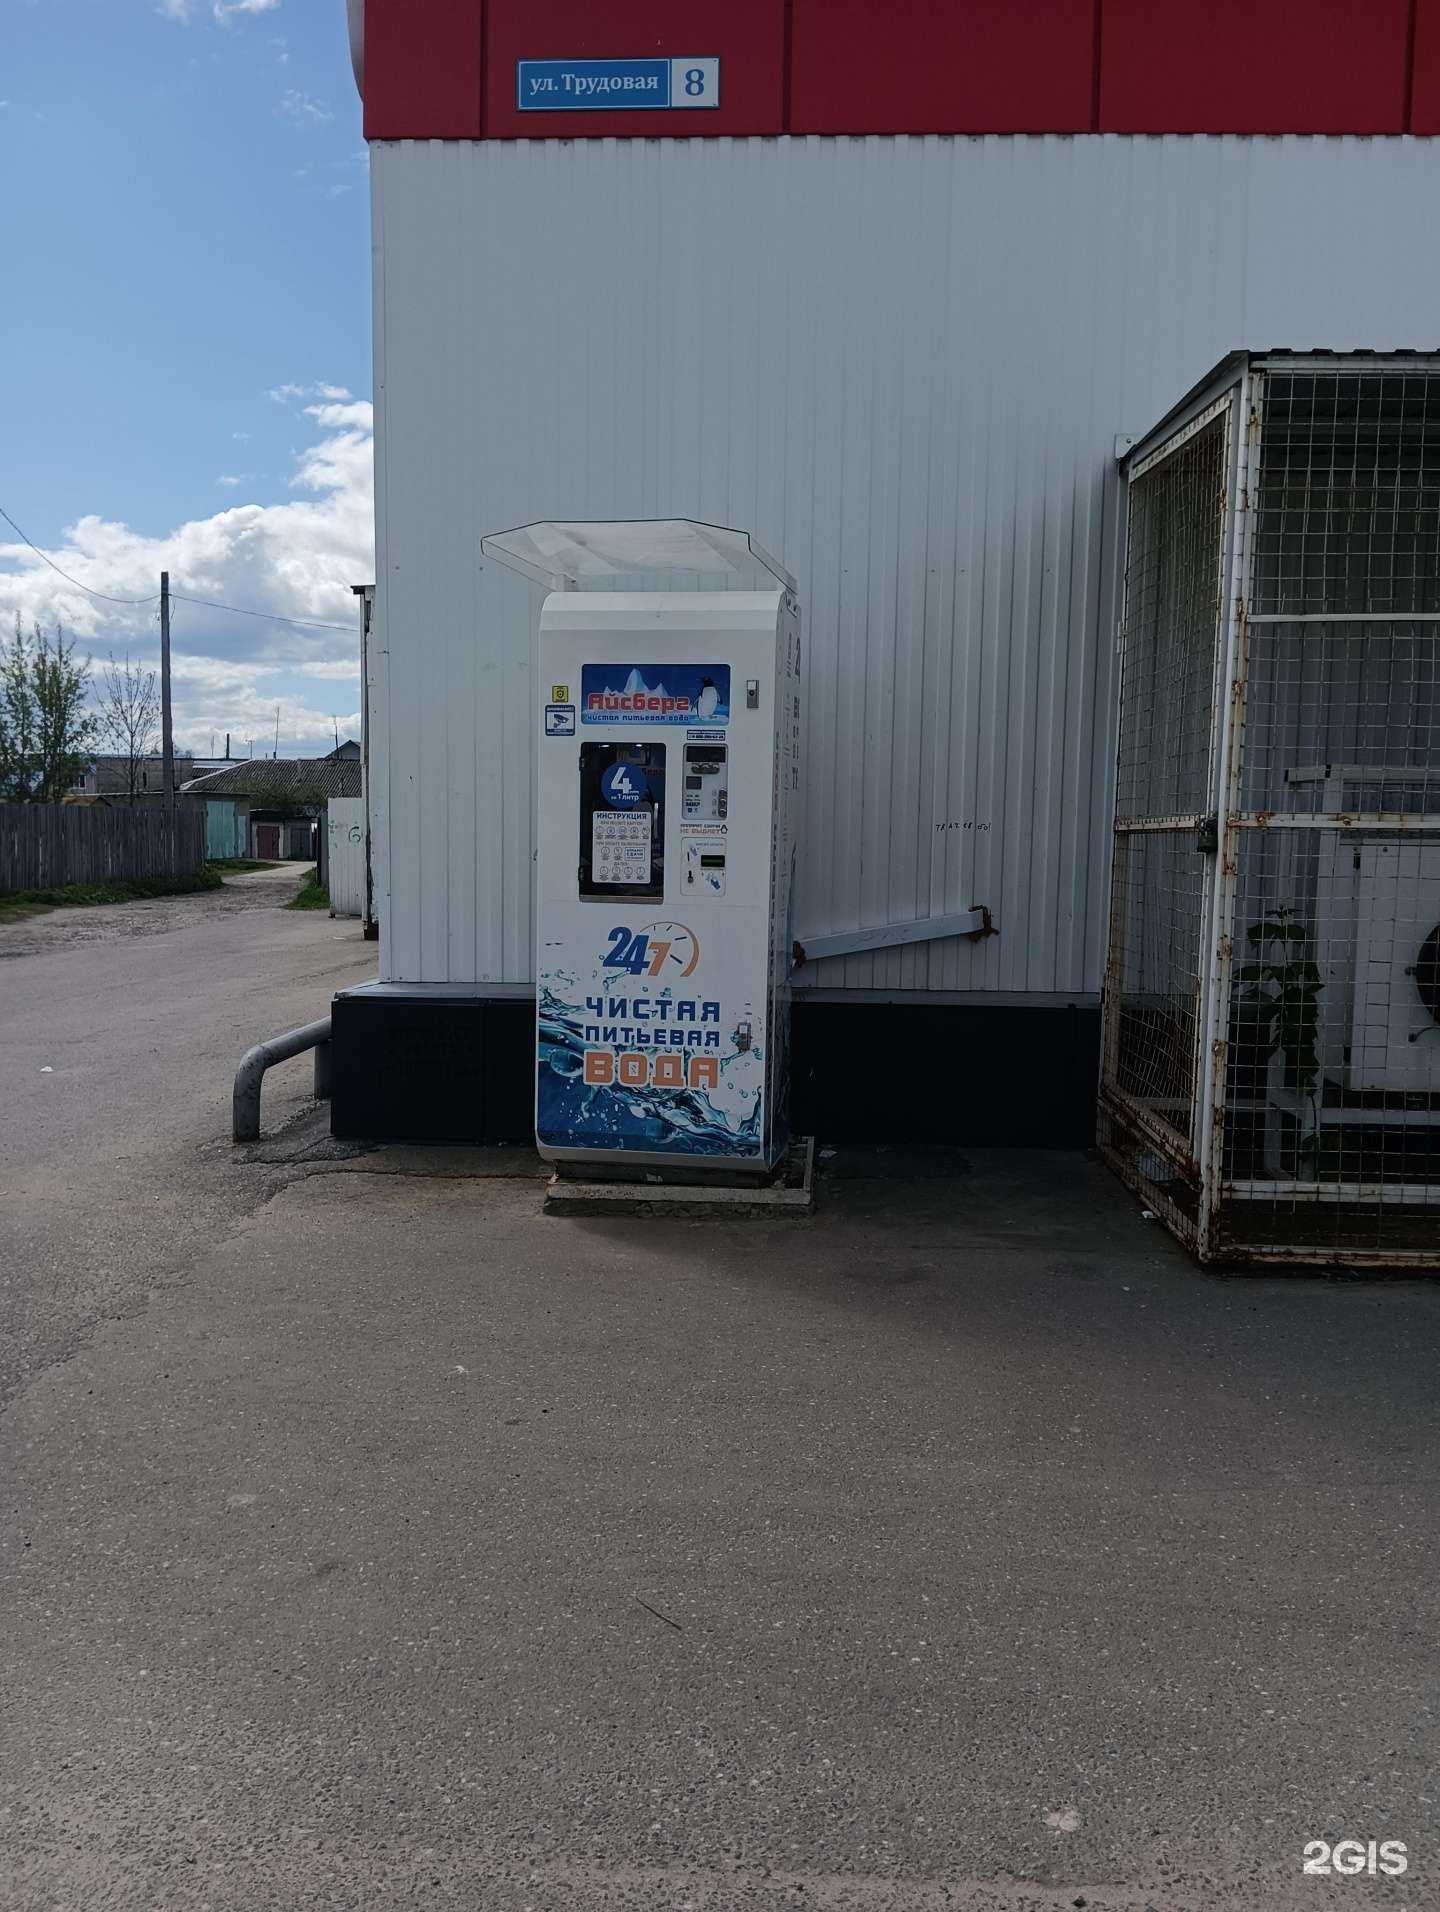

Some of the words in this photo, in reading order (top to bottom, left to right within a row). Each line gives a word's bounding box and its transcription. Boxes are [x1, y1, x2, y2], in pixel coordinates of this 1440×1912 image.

[530, 77, 558, 95] ул.
[561, 73, 659, 95] Трудовая
[684, 69, 705, 96] 8
[587, 692, 690, 714] Айсберг
[610, 766, 633, 794] 4
[596, 812, 647, 820] ИНСТРУКЦИЯ
[585, 996, 721, 1023] ЧИСТАЯ
[585, 1026, 720, 1047] ПИТЬЕВАЯ
[584, 1051, 719, 1089] ВОДА
